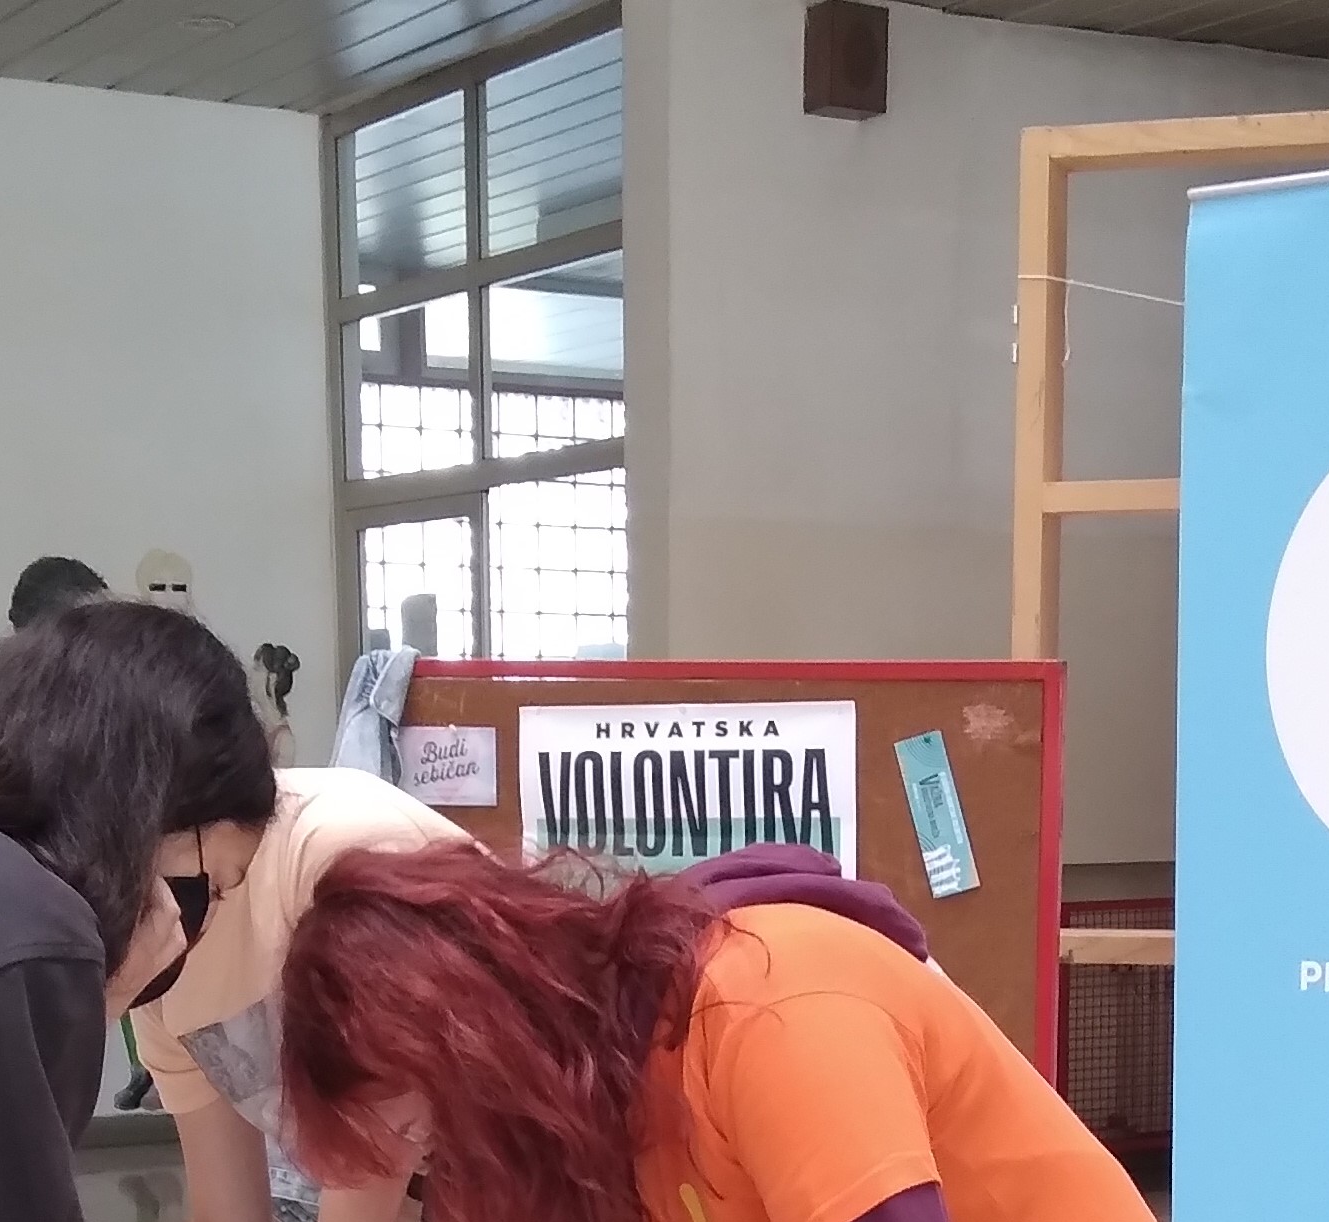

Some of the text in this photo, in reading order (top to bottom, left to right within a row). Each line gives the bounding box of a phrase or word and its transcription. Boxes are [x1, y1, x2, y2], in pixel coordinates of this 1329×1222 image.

[595, 719, 781, 739] HRVATSKA
[420, 738, 468, 765] Budi
[537, 748, 835, 857] VOLONTIRA
